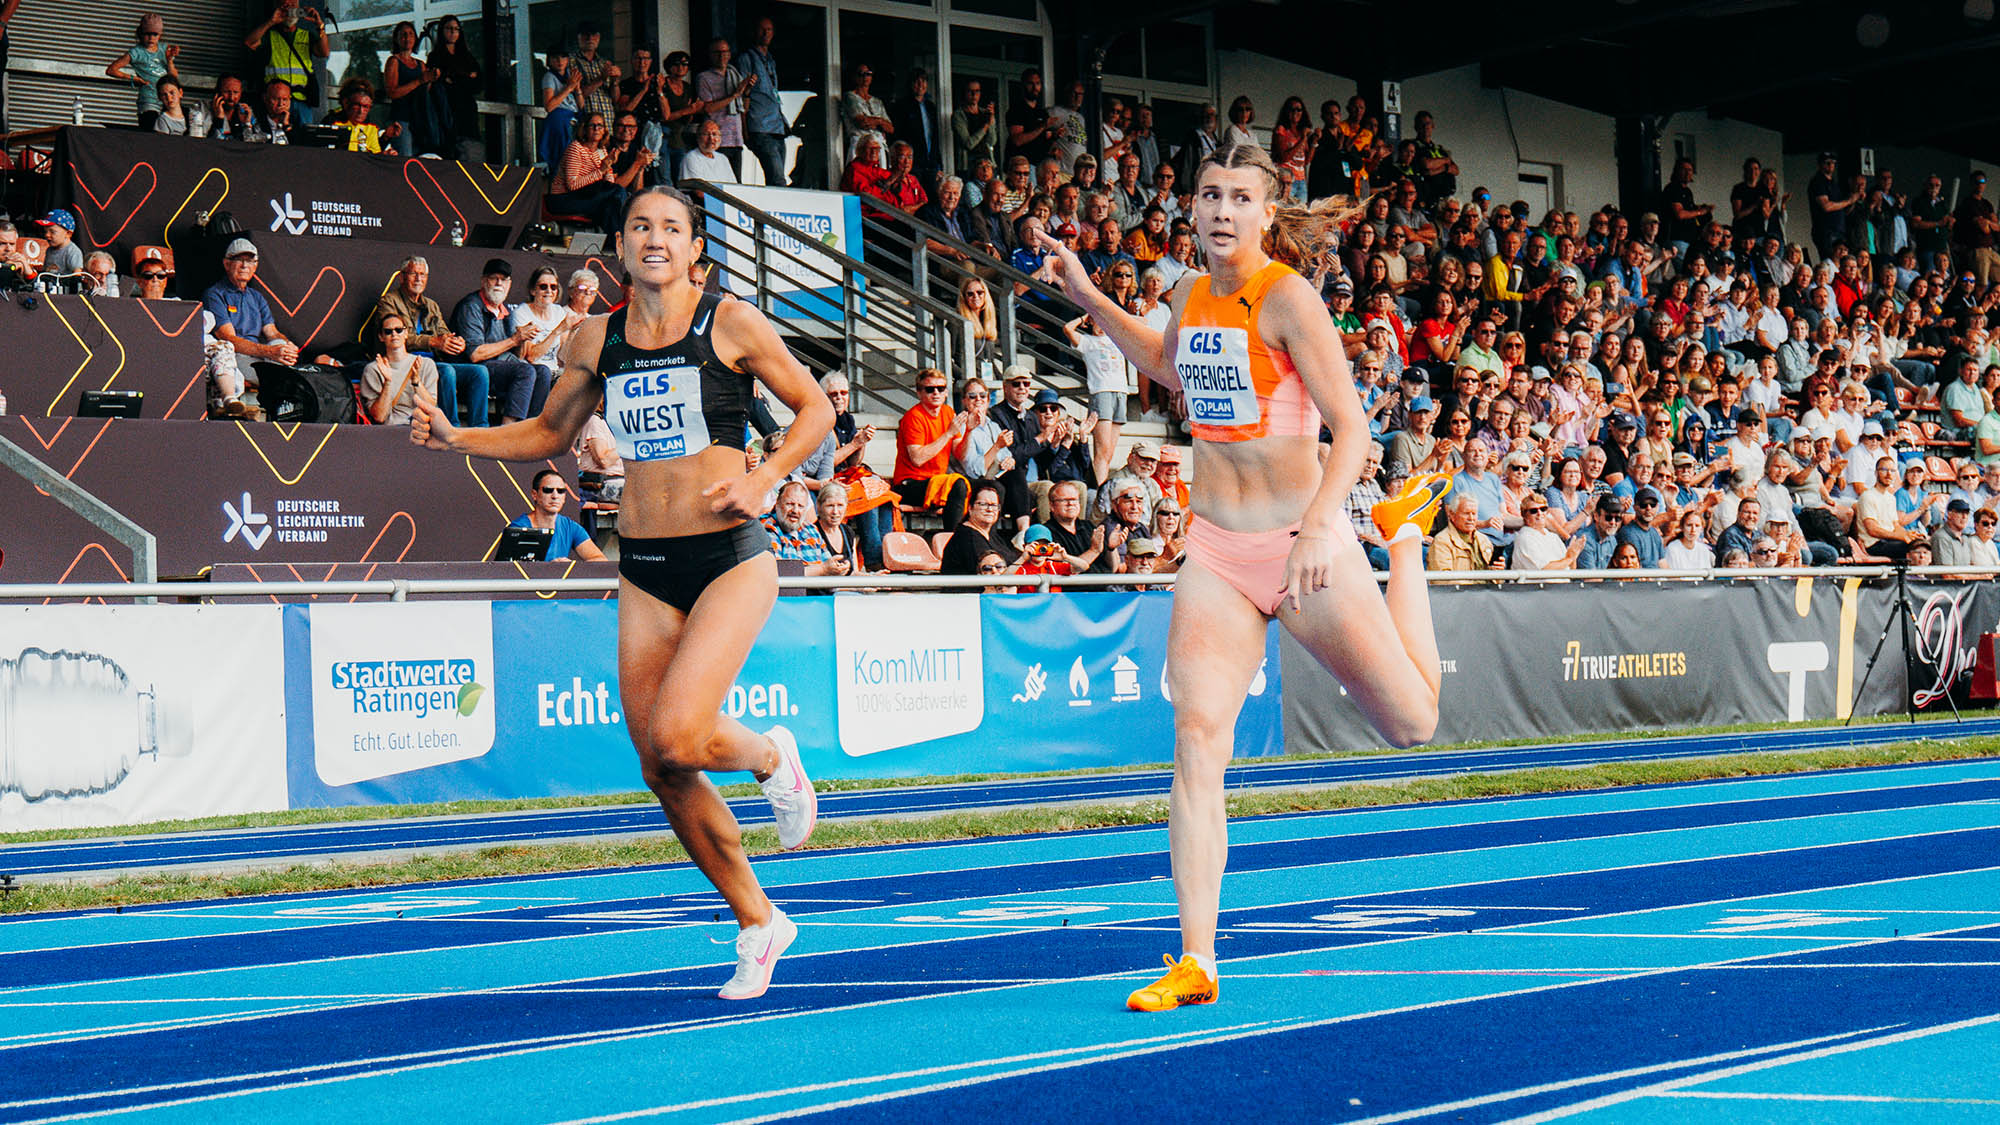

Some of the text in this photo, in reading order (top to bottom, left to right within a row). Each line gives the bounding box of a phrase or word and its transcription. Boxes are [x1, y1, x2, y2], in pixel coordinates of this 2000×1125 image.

[311, 201, 361, 214] DEUTSCHER
[312, 213, 382, 227] LEICHTATHLETIK
[312, 225, 352, 237] VERBAND
[634, 356, 686, 368] btc markets
[1178, 363, 1248, 392] SPRENGEL
[1207, 401, 1232, 412] PLAN
[619, 403, 686, 434] WEST
[653, 439, 683, 452] PLAN
[277, 500, 340, 513] DEUTSCHER
[277, 515, 365, 528] LEICHTATHLETIK
[277, 530, 328, 543] VERBAND
[335, 659, 472, 688] Stadtwerke
[854, 648, 965, 685] KomMITT
[353, 685, 456, 719] Ratingen
[538, 676, 620, 727] Echt.
[856, 689, 968, 712] 100% Stadtwerke
[354, 728, 462, 752] Echt. Gut. Leben.
